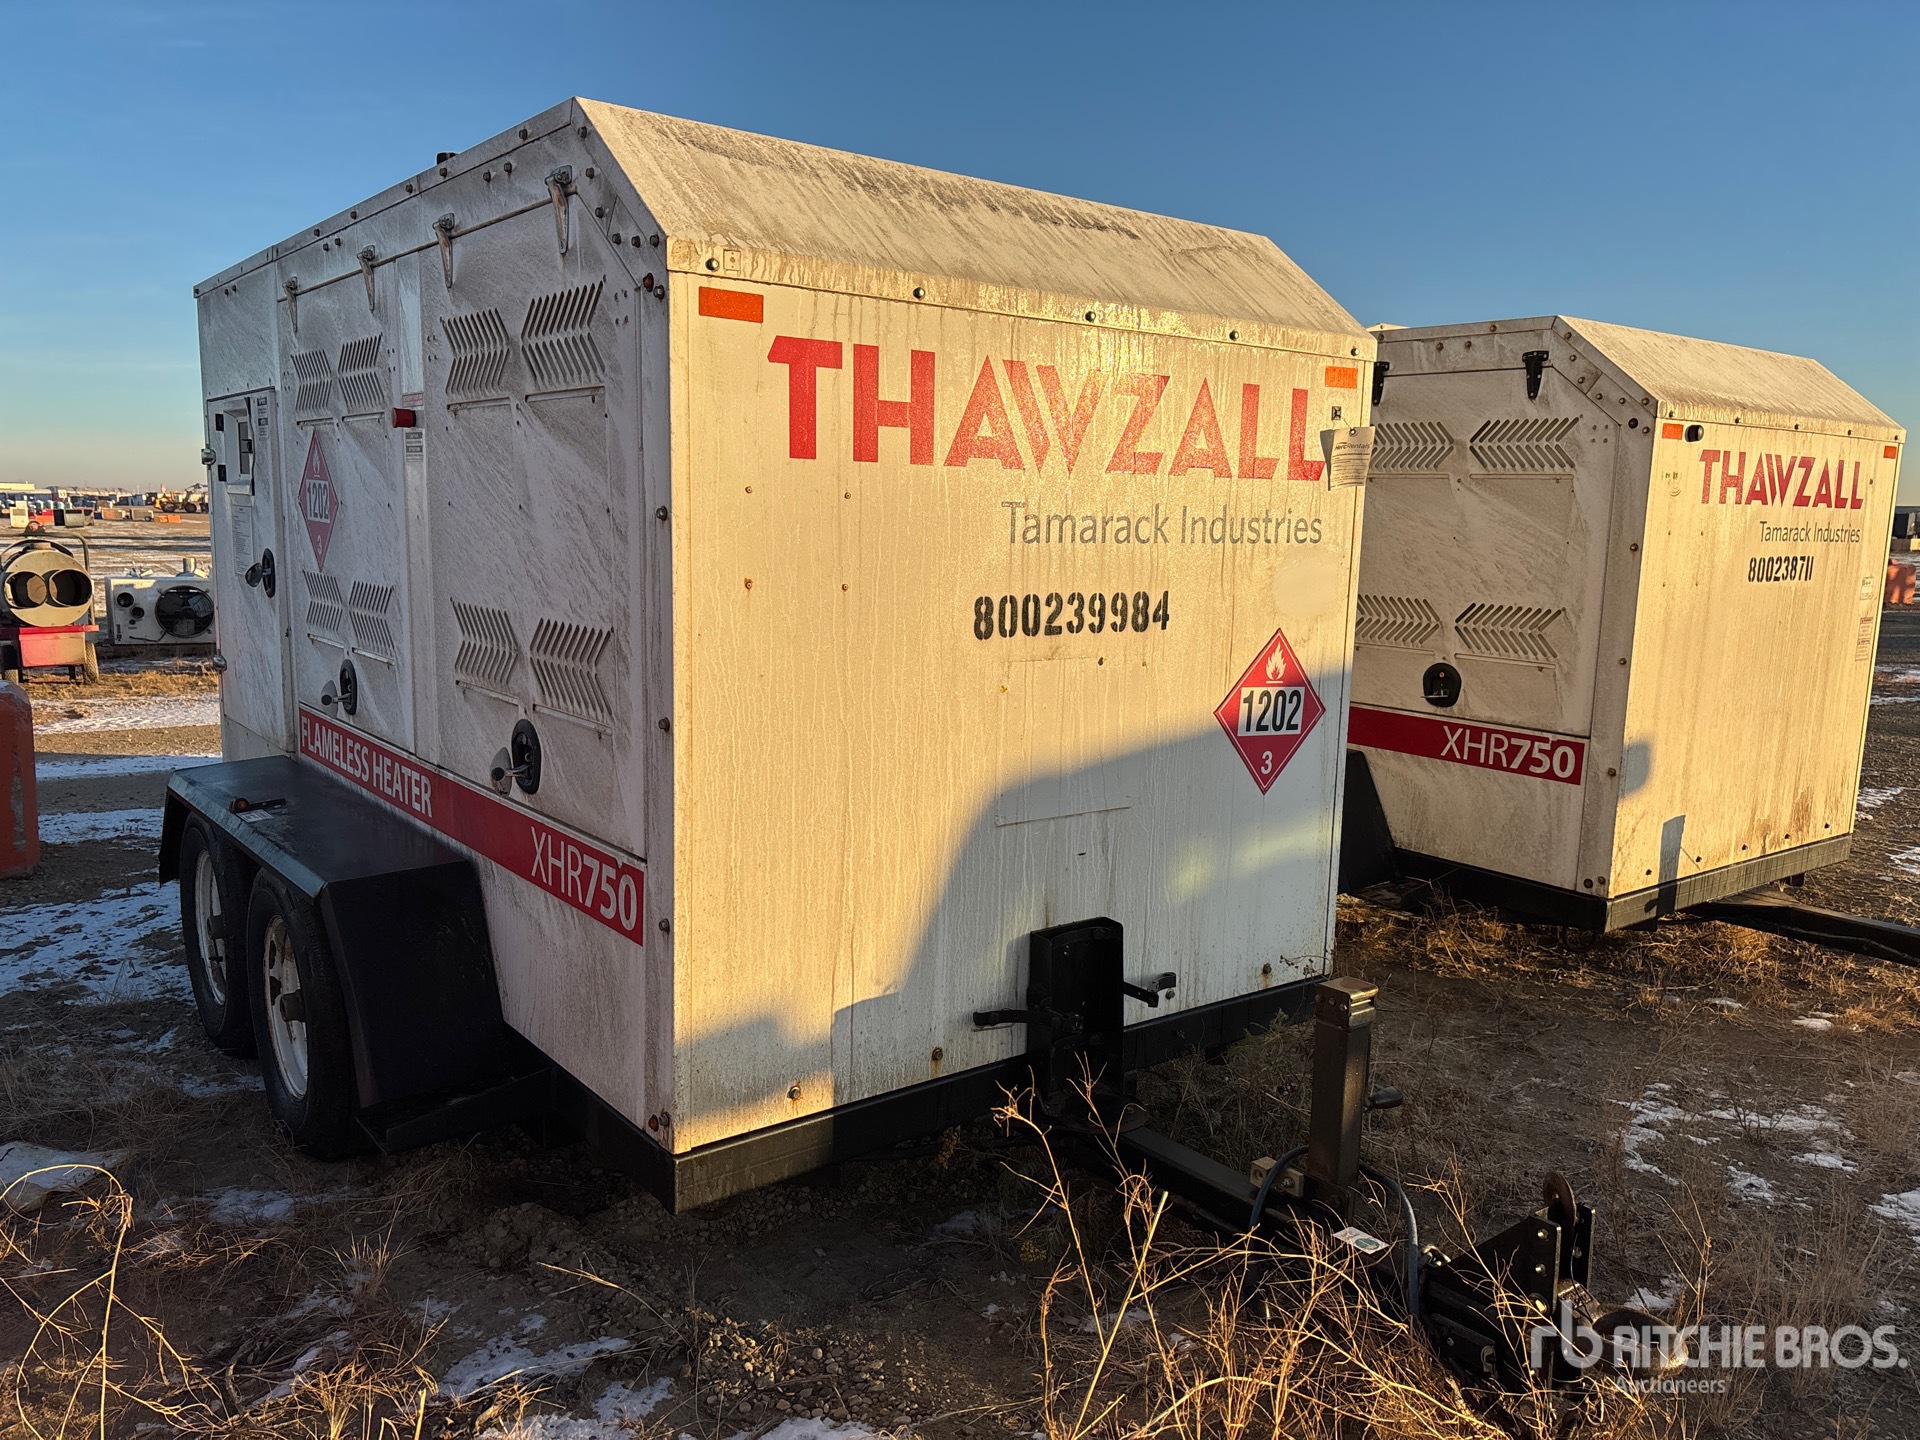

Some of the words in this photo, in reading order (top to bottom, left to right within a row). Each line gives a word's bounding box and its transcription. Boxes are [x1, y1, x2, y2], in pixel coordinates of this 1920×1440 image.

[767, 335, 1326, 482] THAWZALL
[307, 482, 329, 520] 1202
[1699, 449, 1864, 510] THAWZALL
[1001, 501, 1169, 545] Tamarack
[1180, 503, 1323, 545] Industries
[1759, 521, 1811, 543] Tamarack
[1813, 522, 1861, 543] Industries
[1748, 556, 1815, 583] 800238711
[973, 590, 1170, 641] 800239984
[1243, 690, 1302, 732] 1202
[301, 716, 370, 783] FLAMELESS
[371, 749, 433, 819] HEATER
[1260, 750, 1273, 775] 3
[1440, 725, 1576, 778] XHR750
[531, 826, 638, 932] XHR750
